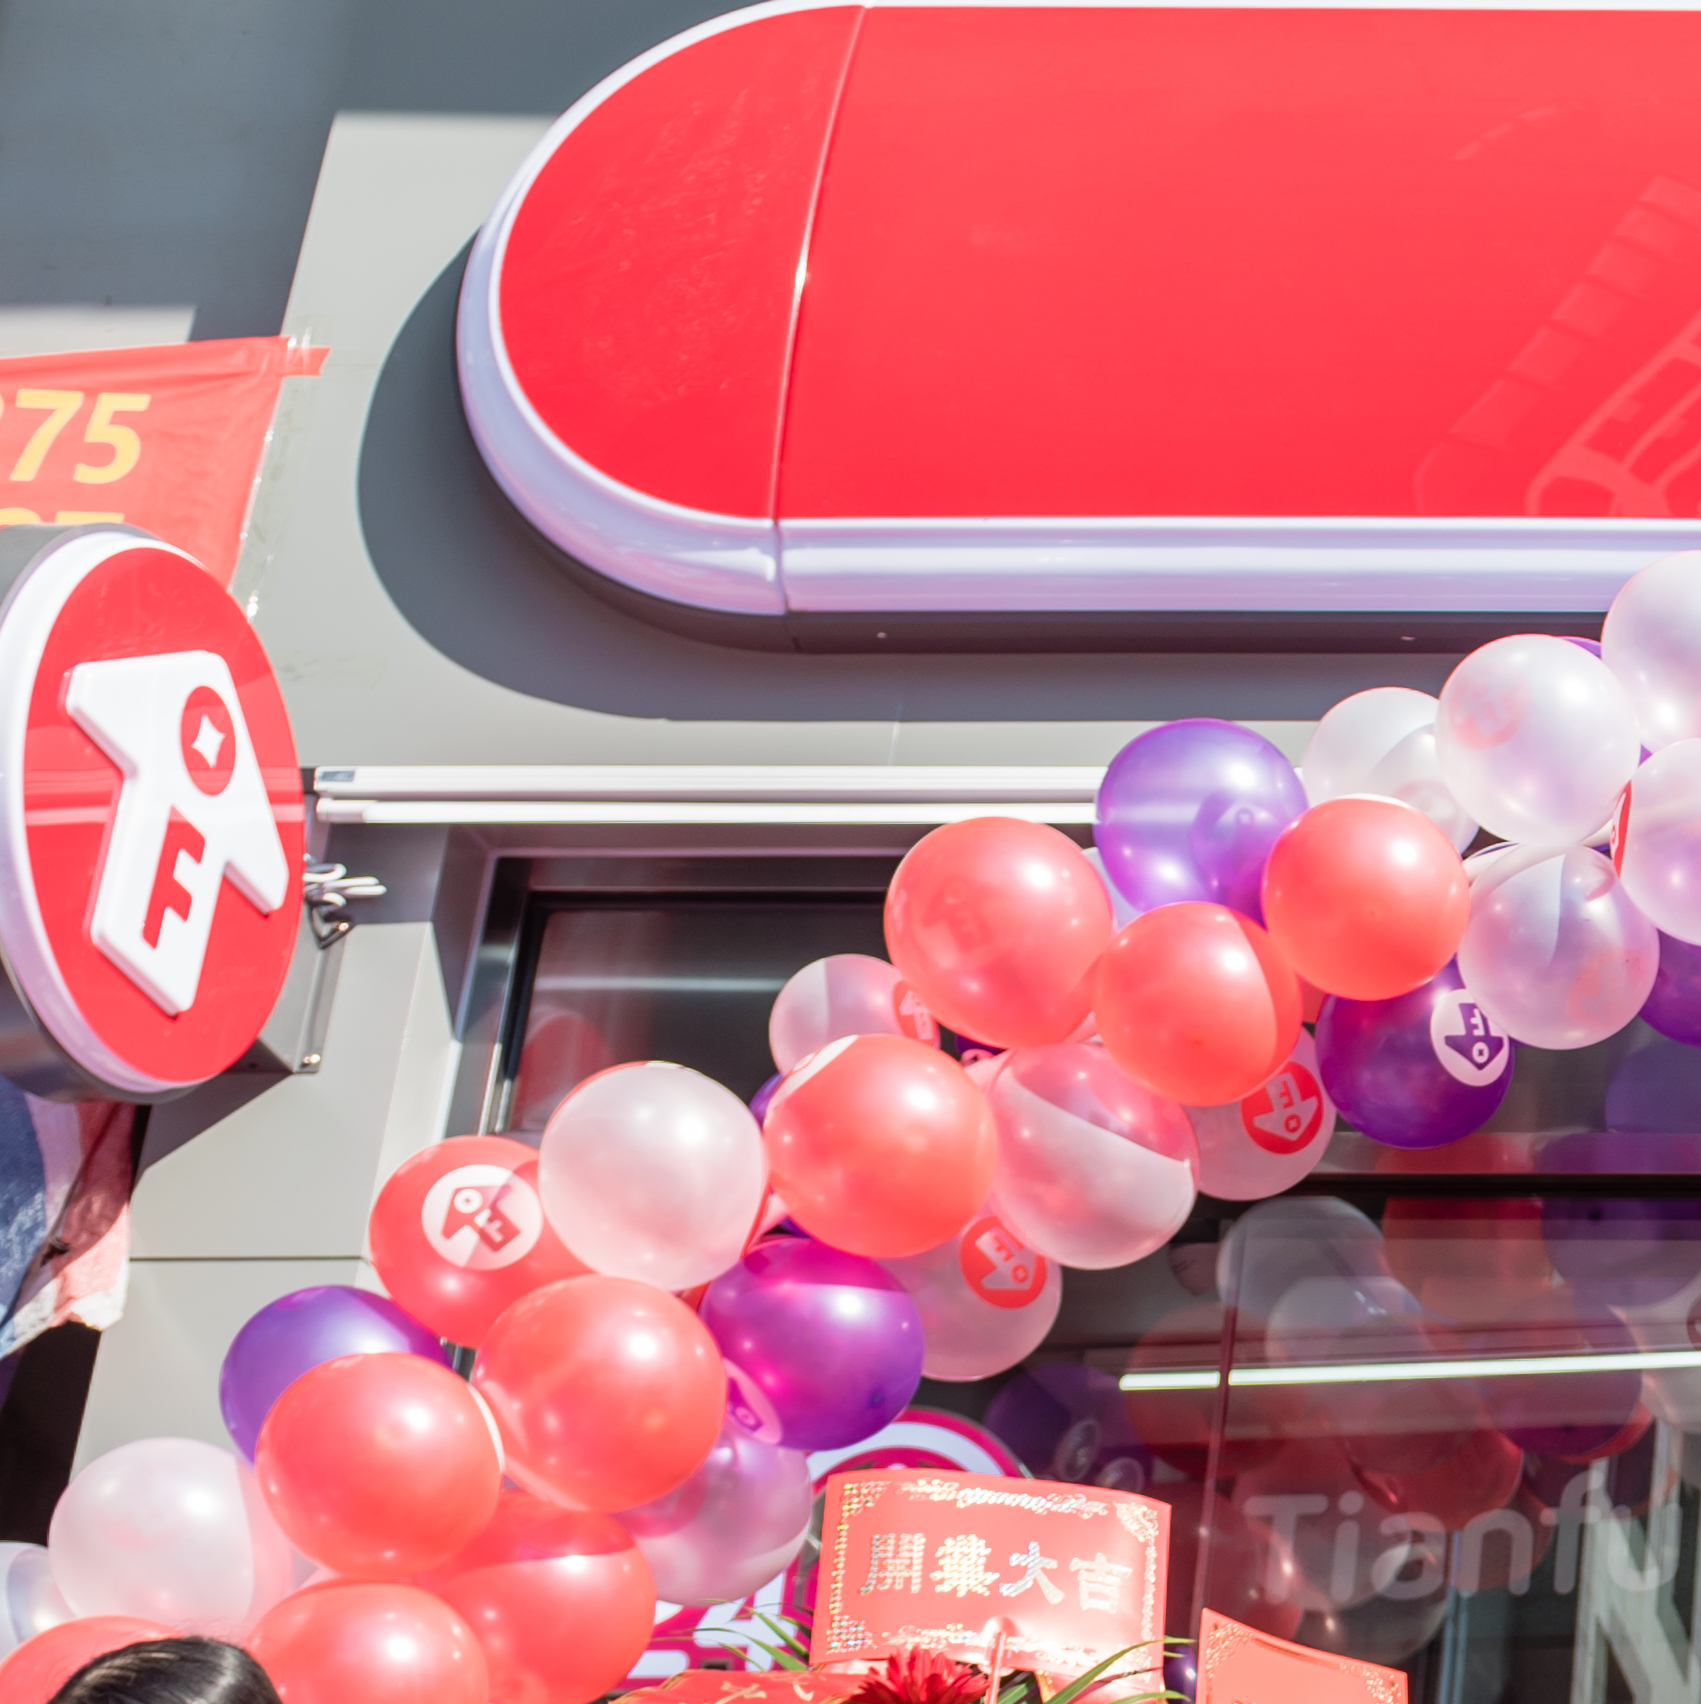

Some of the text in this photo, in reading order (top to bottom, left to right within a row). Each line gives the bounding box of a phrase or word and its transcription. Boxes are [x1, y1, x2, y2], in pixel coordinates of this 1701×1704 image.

[0, 388, 152, 485] 75
[858, 1532, 1134, 1614] 開業大吉
[1243, 1468, 1684, 1606] Tianfu
